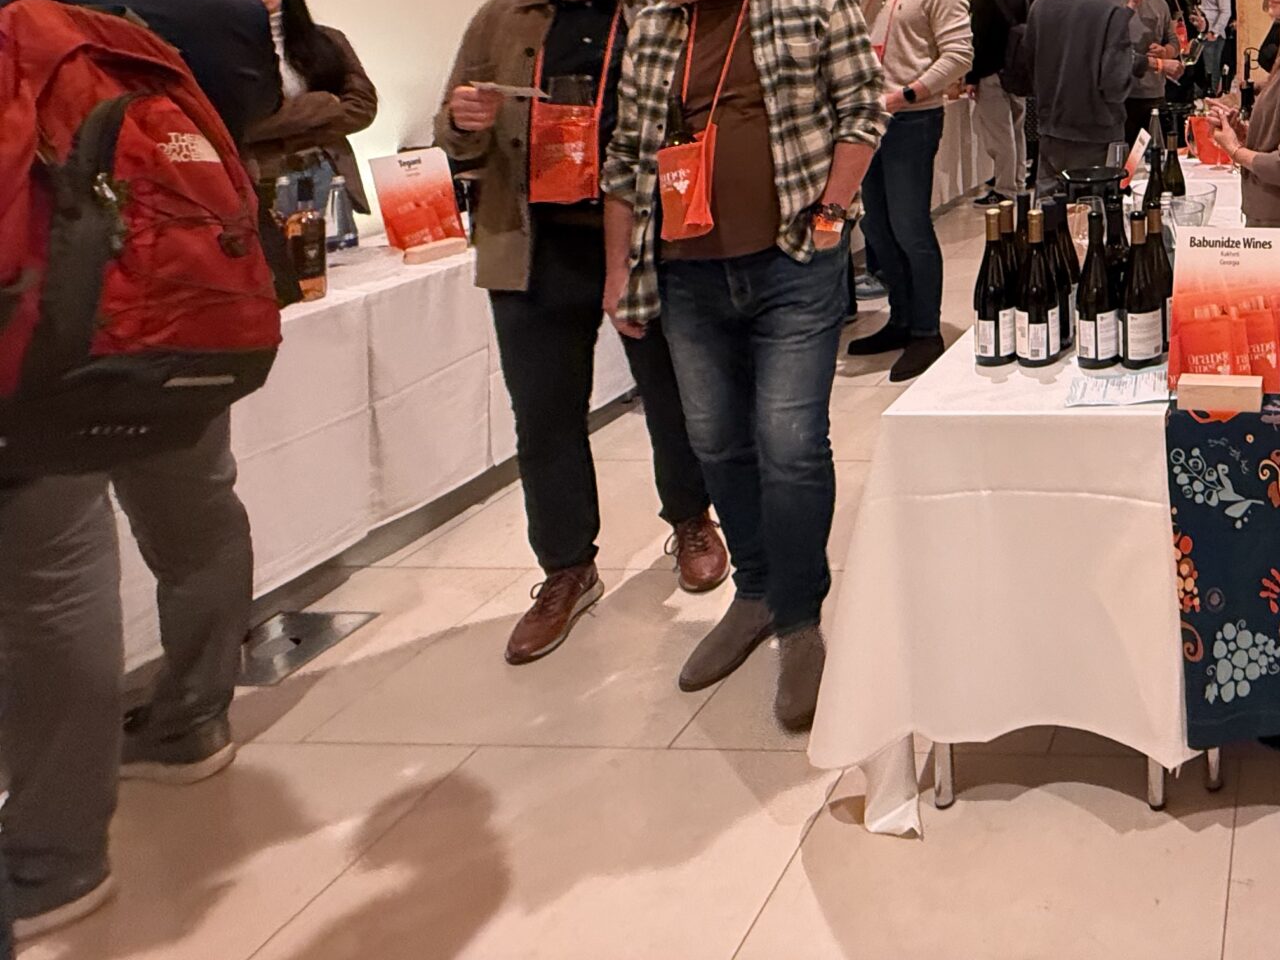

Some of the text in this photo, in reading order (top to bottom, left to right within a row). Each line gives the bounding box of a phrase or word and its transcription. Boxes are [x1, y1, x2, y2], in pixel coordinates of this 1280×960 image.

[167, 132, 197, 143] THE
[156, 142, 197, 154] ORTH
[1189, 236, 1272, 249] Babunidze Wines
[1219, 259, 1240, 267] Georgia
